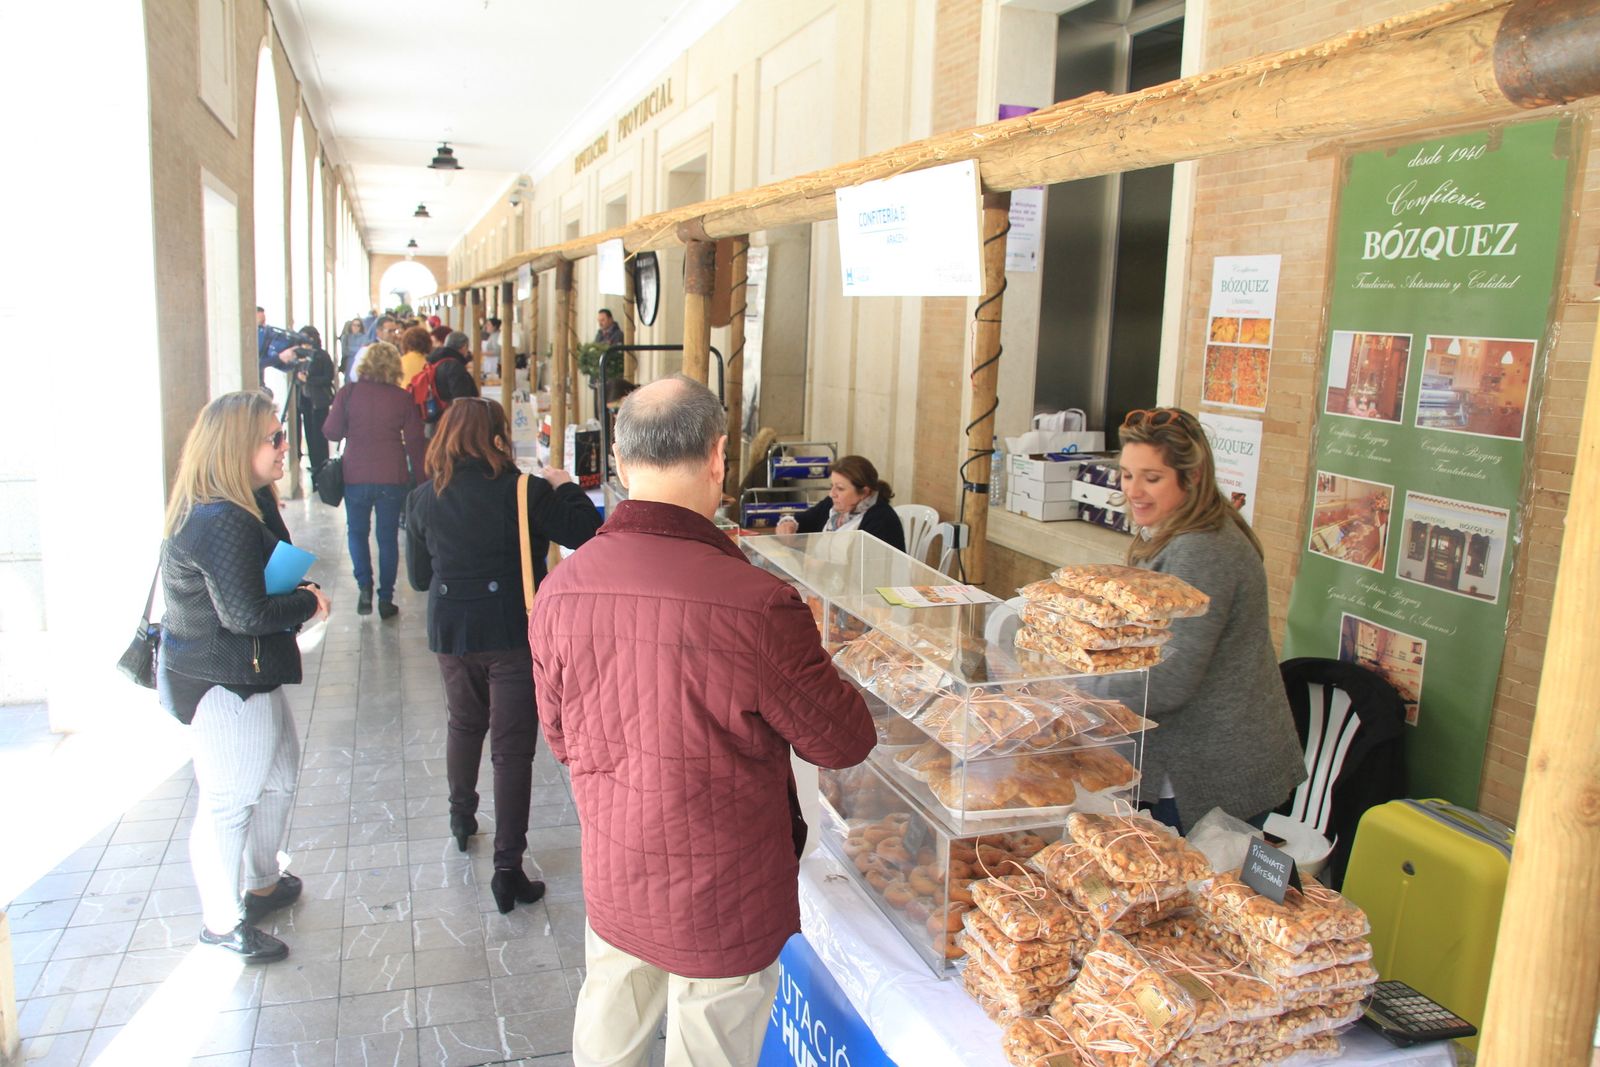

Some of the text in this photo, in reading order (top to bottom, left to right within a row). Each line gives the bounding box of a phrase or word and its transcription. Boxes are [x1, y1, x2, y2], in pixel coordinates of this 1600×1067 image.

[617, 77, 674, 143] PROVINCIAL
[1407, 144, 1488, 168] desde 1940
[1386, 179, 1487, 216] Confitería
[1361, 222, 1519, 261] BÓZQUEZ
[1221, 276, 1270, 295] BÓZQUEZ
[1468, 269, 1521, 289] Calidad
[1207, 436, 1254, 456] ÓZQUEZ
[1251, 862, 1283, 888] ARTESANO
[778, 961, 851, 1067] UTACIÓ
